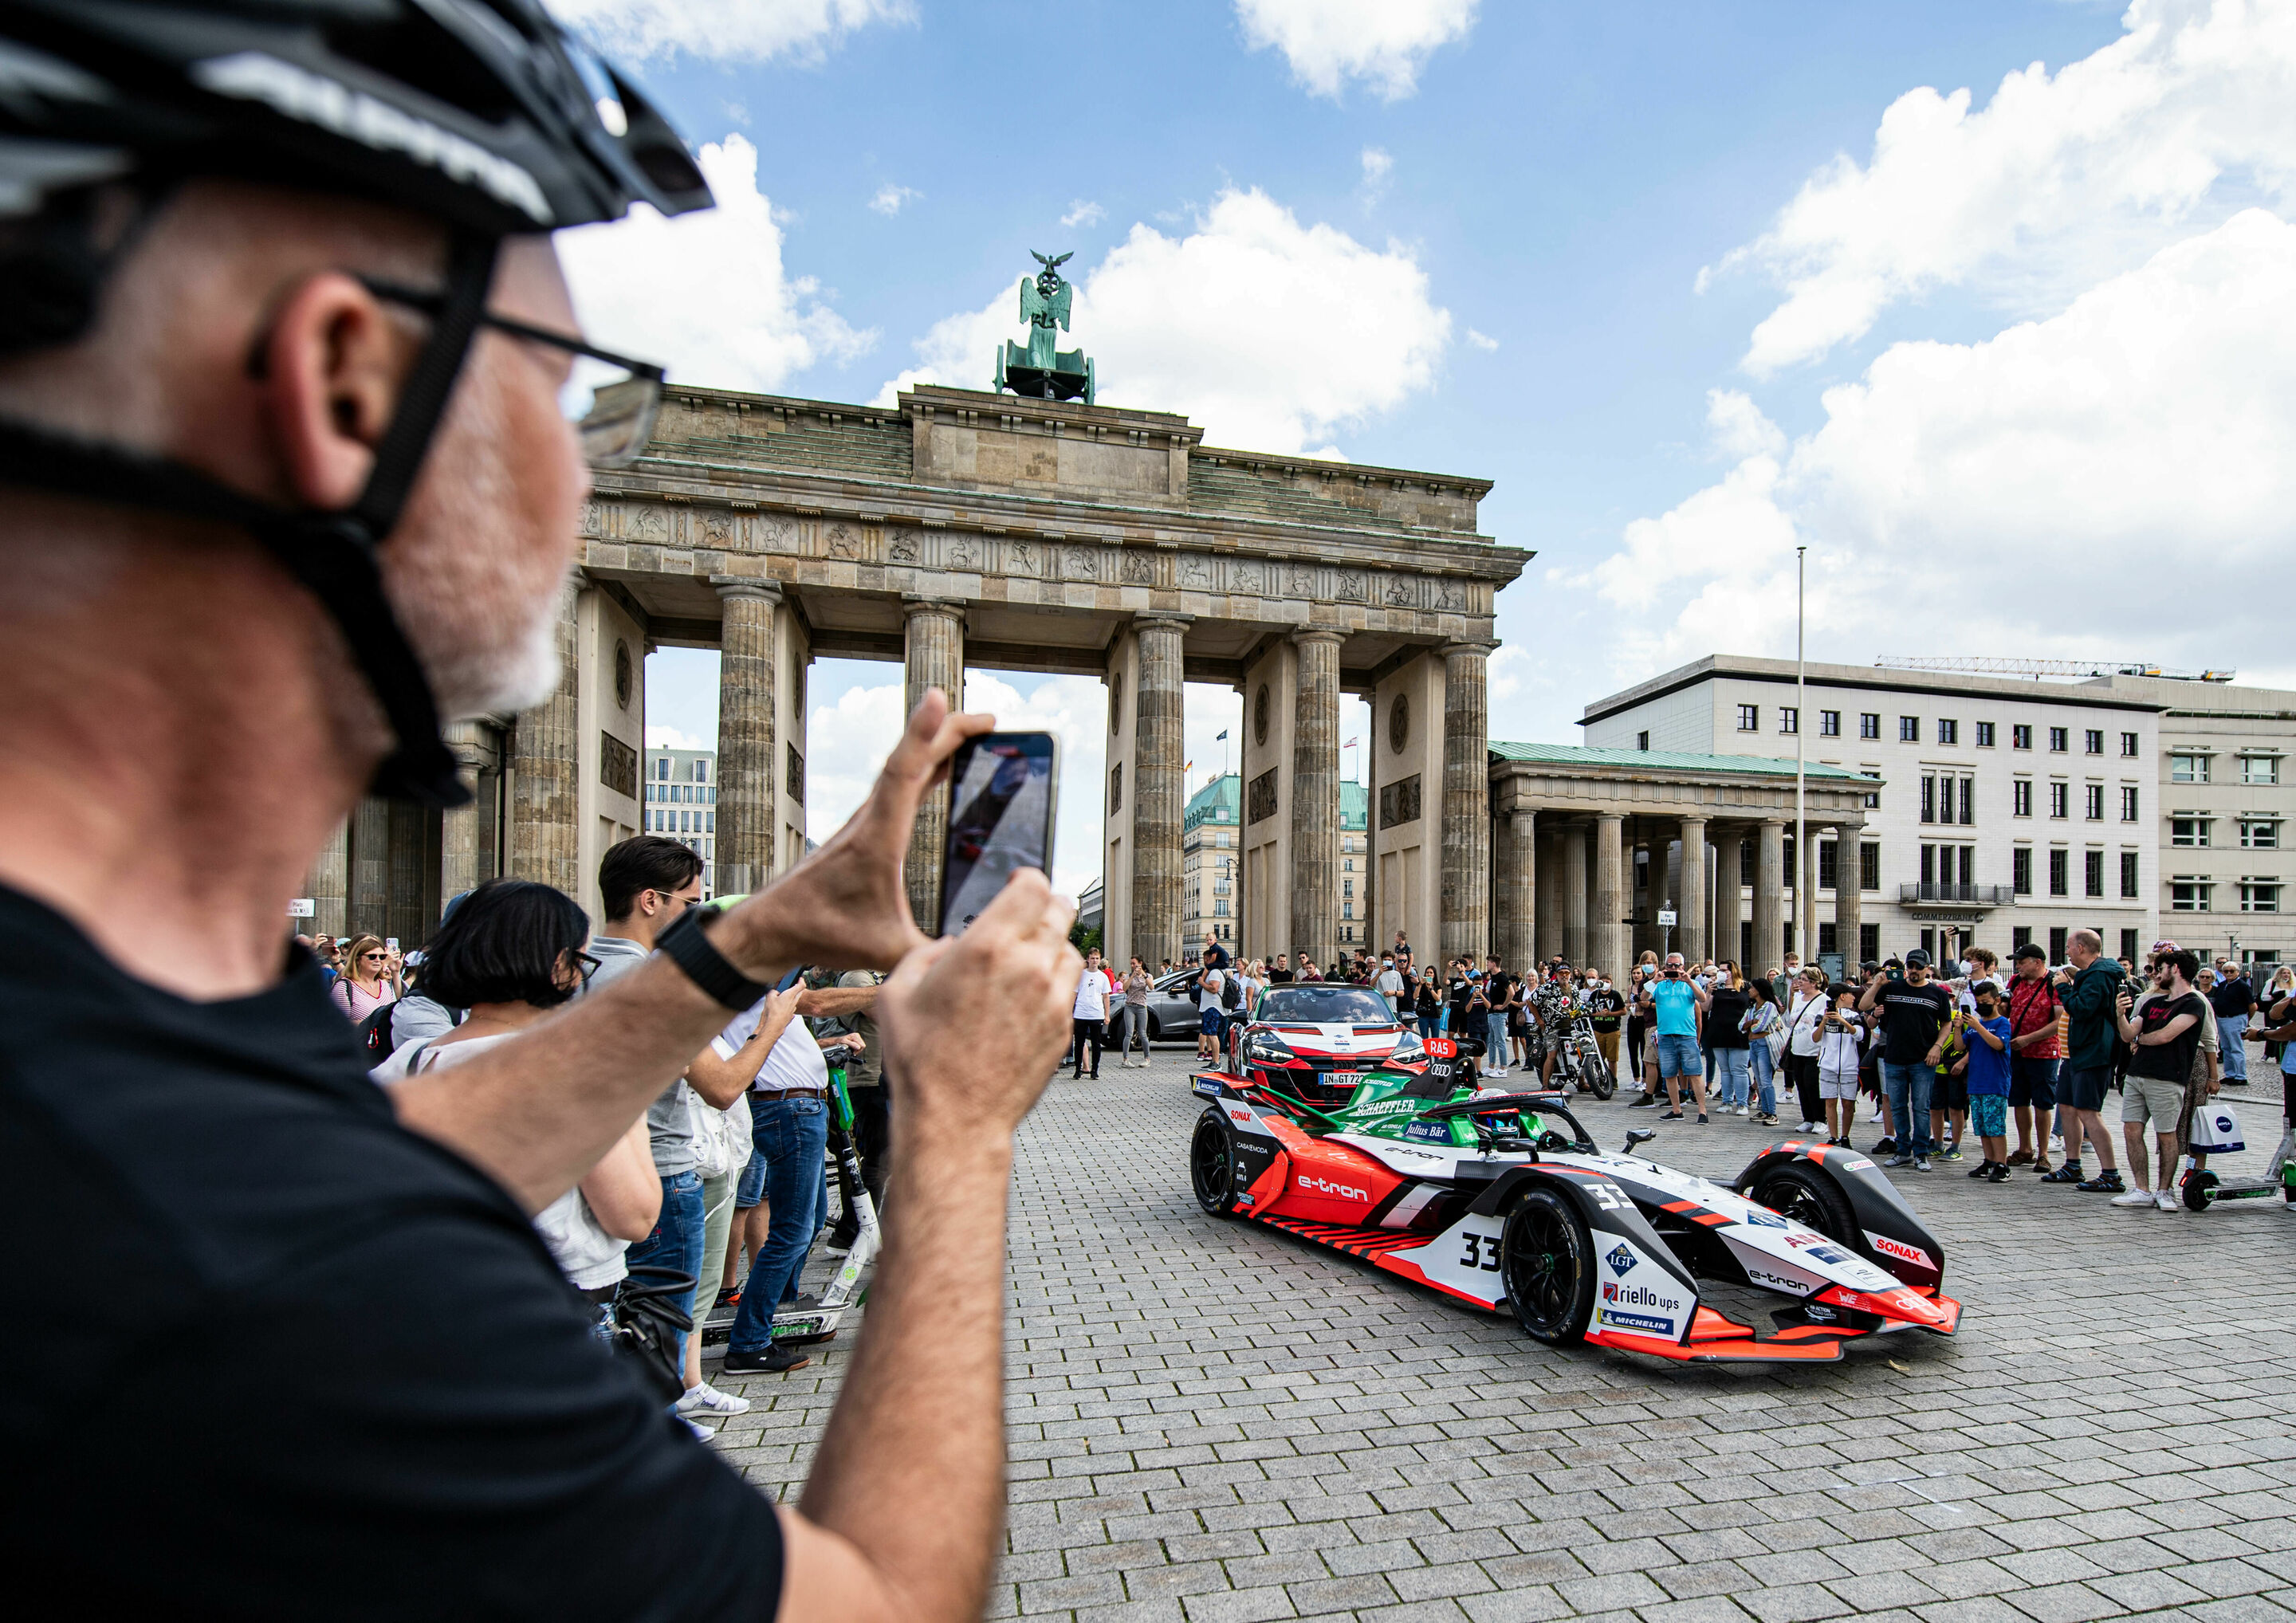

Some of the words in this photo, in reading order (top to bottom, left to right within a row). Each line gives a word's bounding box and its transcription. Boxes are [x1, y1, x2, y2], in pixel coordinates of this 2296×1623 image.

[1912, 913, 1974, 922] COMMERZBANK
[1430, 1040, 1449, 1055] RAS
[1324, 1075, 1334, 1083] IN
[1339, 1075, 1350, 1083] GT
[1357, 1099, 1415, 1116] SCHAEFFLER
[1230, 1110, 1251, 1122] SONAX
[1406, 1124, 1428, 1135] Julius
[1429, 1126, 1446, 1138] Bär
[1385, 1147, 1445, 1161] e-tron
[1298, 1175, 1368, 1202] e-tron
[1460, 1232, 1502, 1273] 33
[1876, 1239, 1921, 1262] SONAX
[1610, 1254, 1634, 1267] LGT
[1749, 1269, 1810, 1292] e-tron
[1620, 1285, 1657, 1306] riello
[1660, 1298, 1680, 1311] ups
[1838, 1291, 1858, 1305] WE
[1815, 1305, 1831, 1314] ACTION
[1615, 1316, 1667, 1330] MICHELIN
